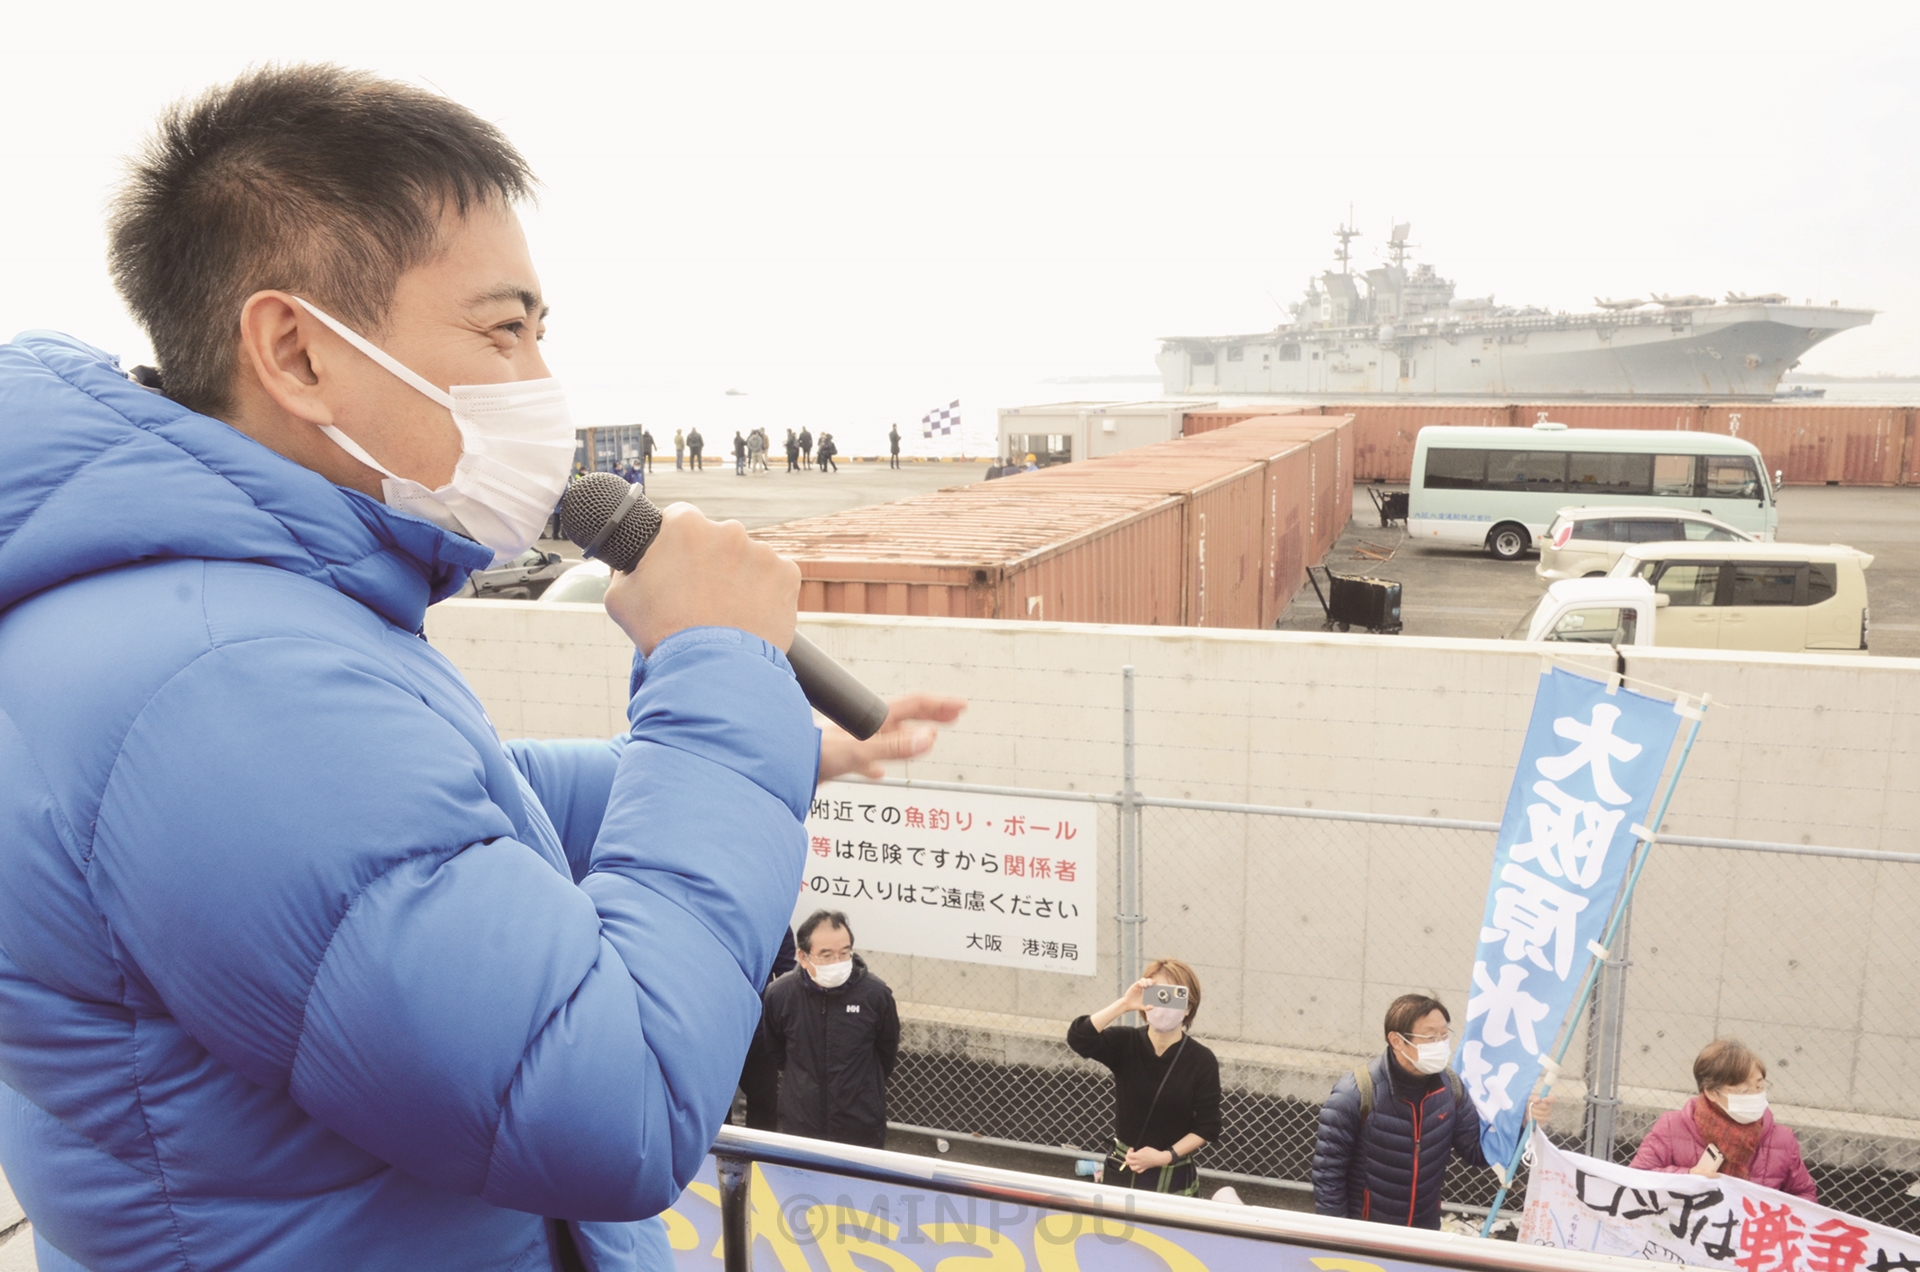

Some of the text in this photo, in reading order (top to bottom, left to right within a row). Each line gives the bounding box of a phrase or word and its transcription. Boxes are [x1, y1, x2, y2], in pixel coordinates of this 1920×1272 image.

[810, 799, 1078, 841] 附近での魚釣り・ボール
[811, 836, 1077, 883] 等は危険ですから関係者
[965, 932, 1079, 961] 大阪 港湾局
